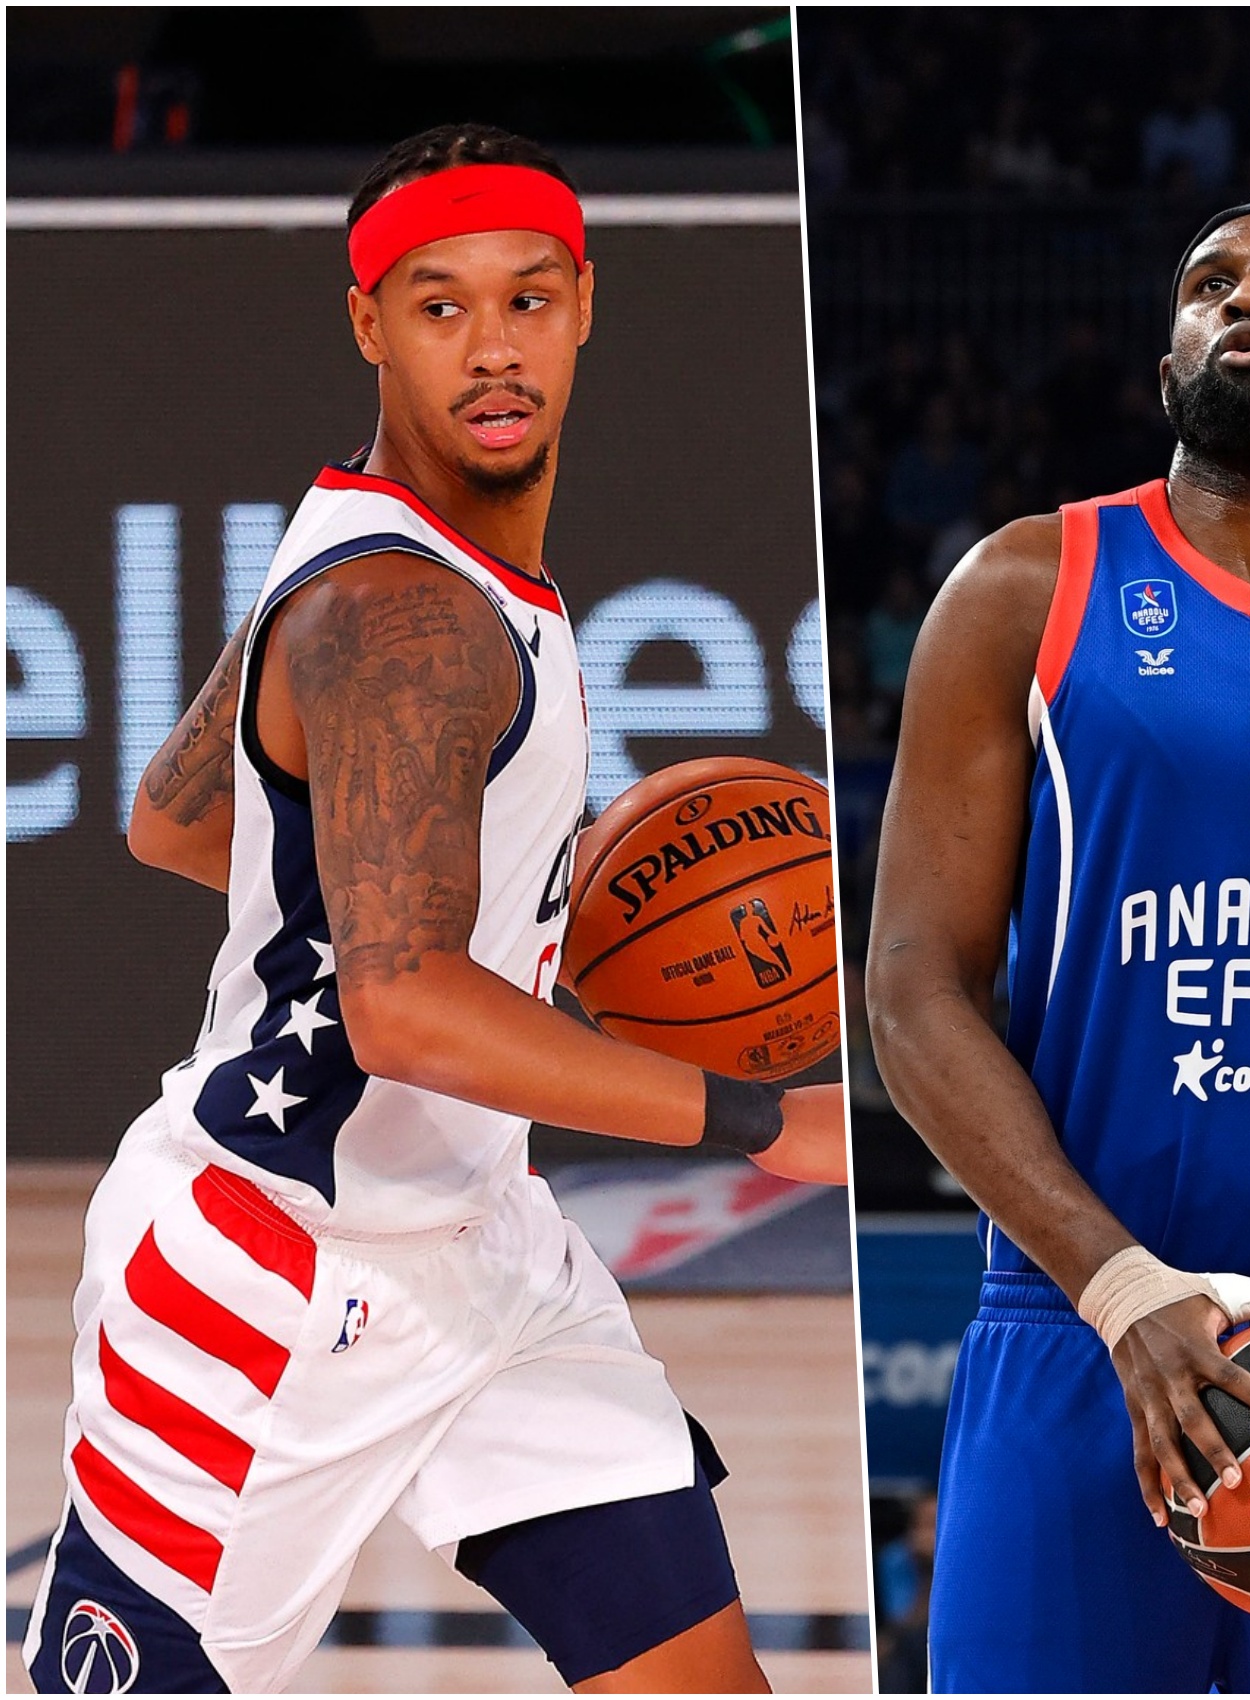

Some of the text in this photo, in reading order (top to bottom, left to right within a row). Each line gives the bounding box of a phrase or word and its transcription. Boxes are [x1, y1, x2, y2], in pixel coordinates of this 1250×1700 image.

[1132, 608, 1169, 620] ANADOLU
[1138, 616, 1165, 625] EFES
[1138, 666, 1175, 676] bilcee
[608, 796, 824, 924] SPALDING
[759, 967, 780, 985] NBA
